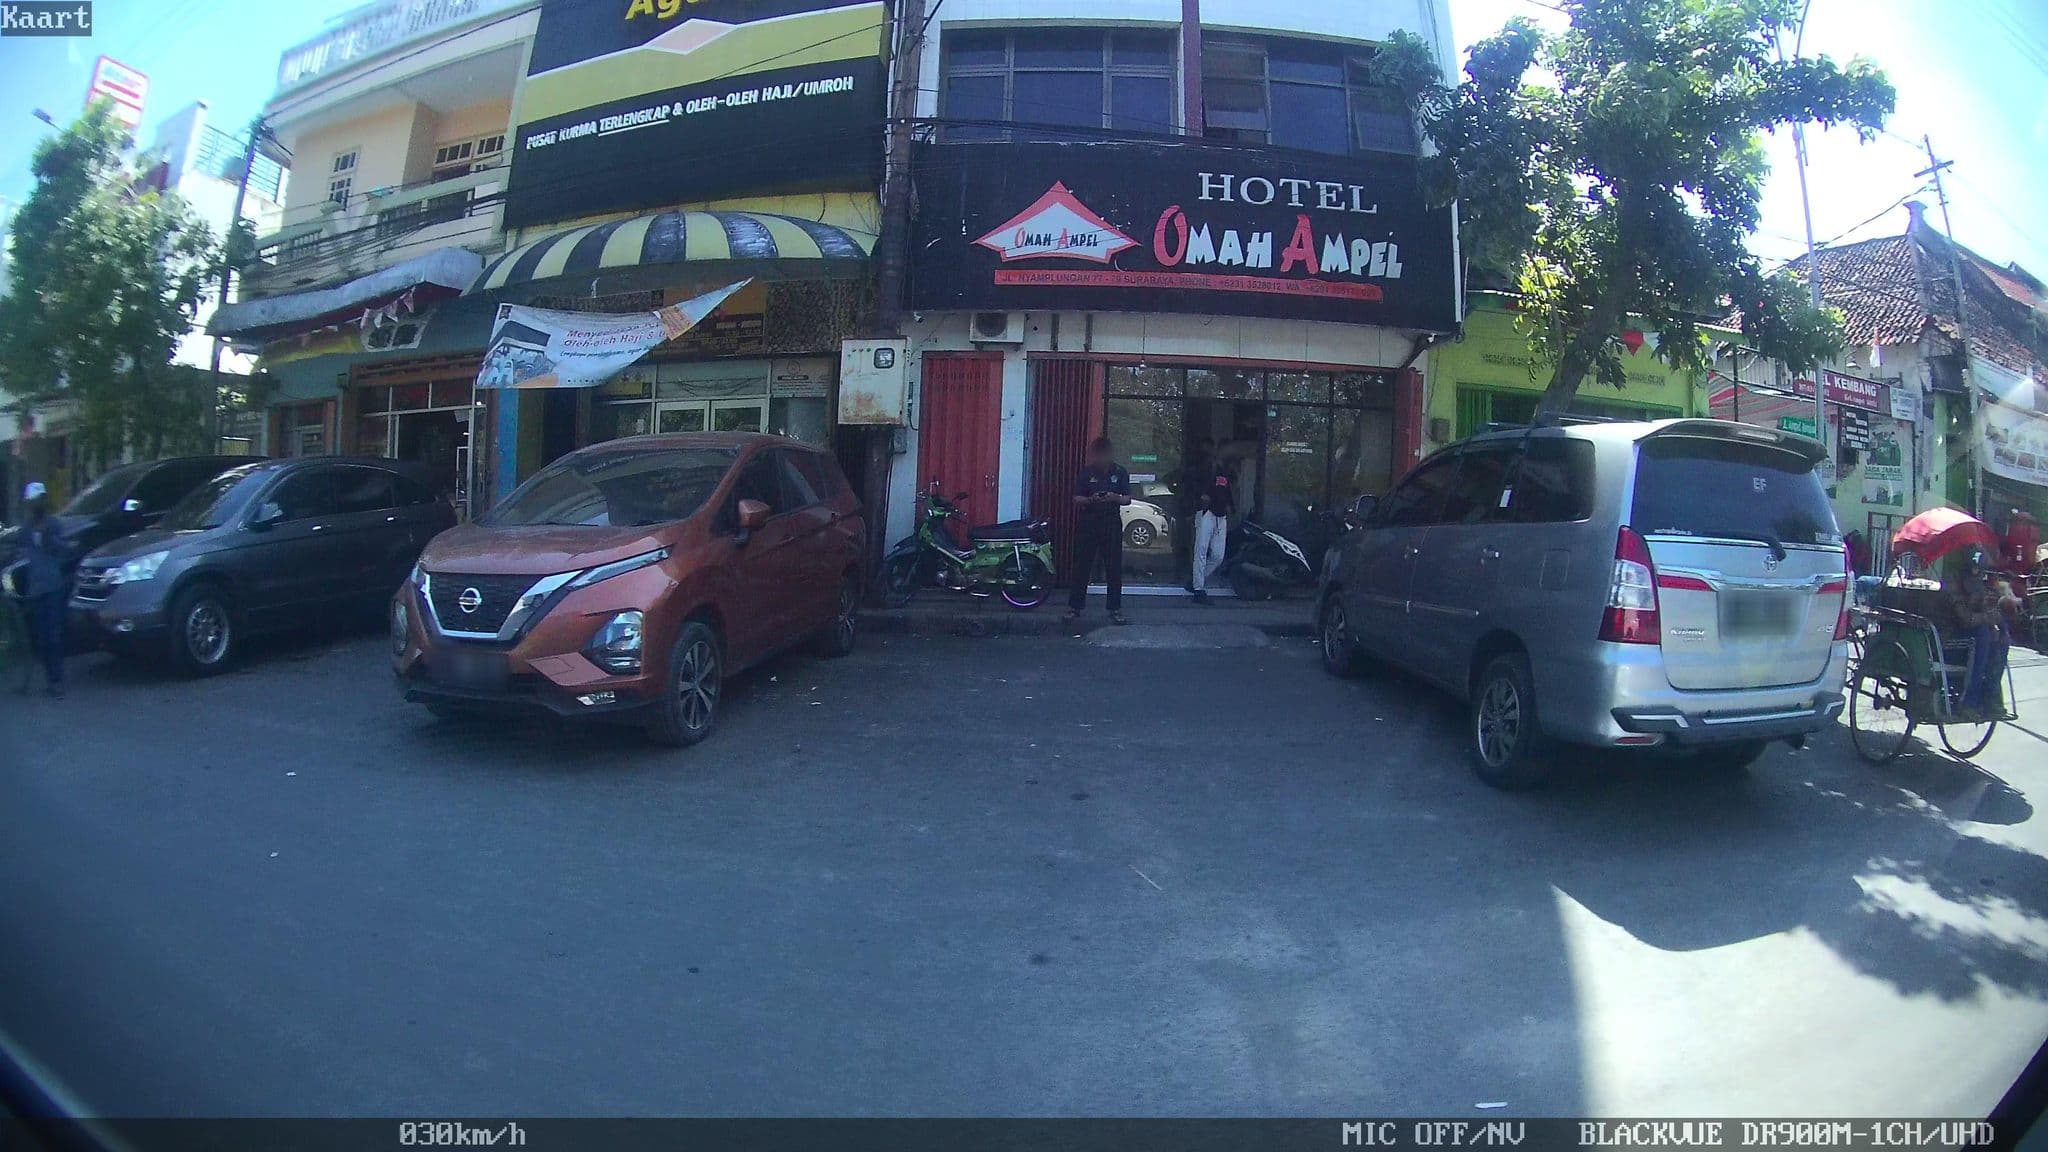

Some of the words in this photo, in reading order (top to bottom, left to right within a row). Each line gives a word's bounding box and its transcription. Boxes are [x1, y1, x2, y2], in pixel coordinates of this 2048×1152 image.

[526, 130, 558, 150] PUSAT
[559, 121, 598, 142] KURMA
[599, 105, 671, 132] TERLENGKAP
[673, 102, 683, 117] &
[686, 88, 758, 114] OLEH-OLEH
[761, 76, 854, 102] HAJI/UMROH
[1198, 174, 1377, 213] HOTEL
[620, 334, 642, 344] Haji
[1834, 376, 1877, 397] KEMBANG
